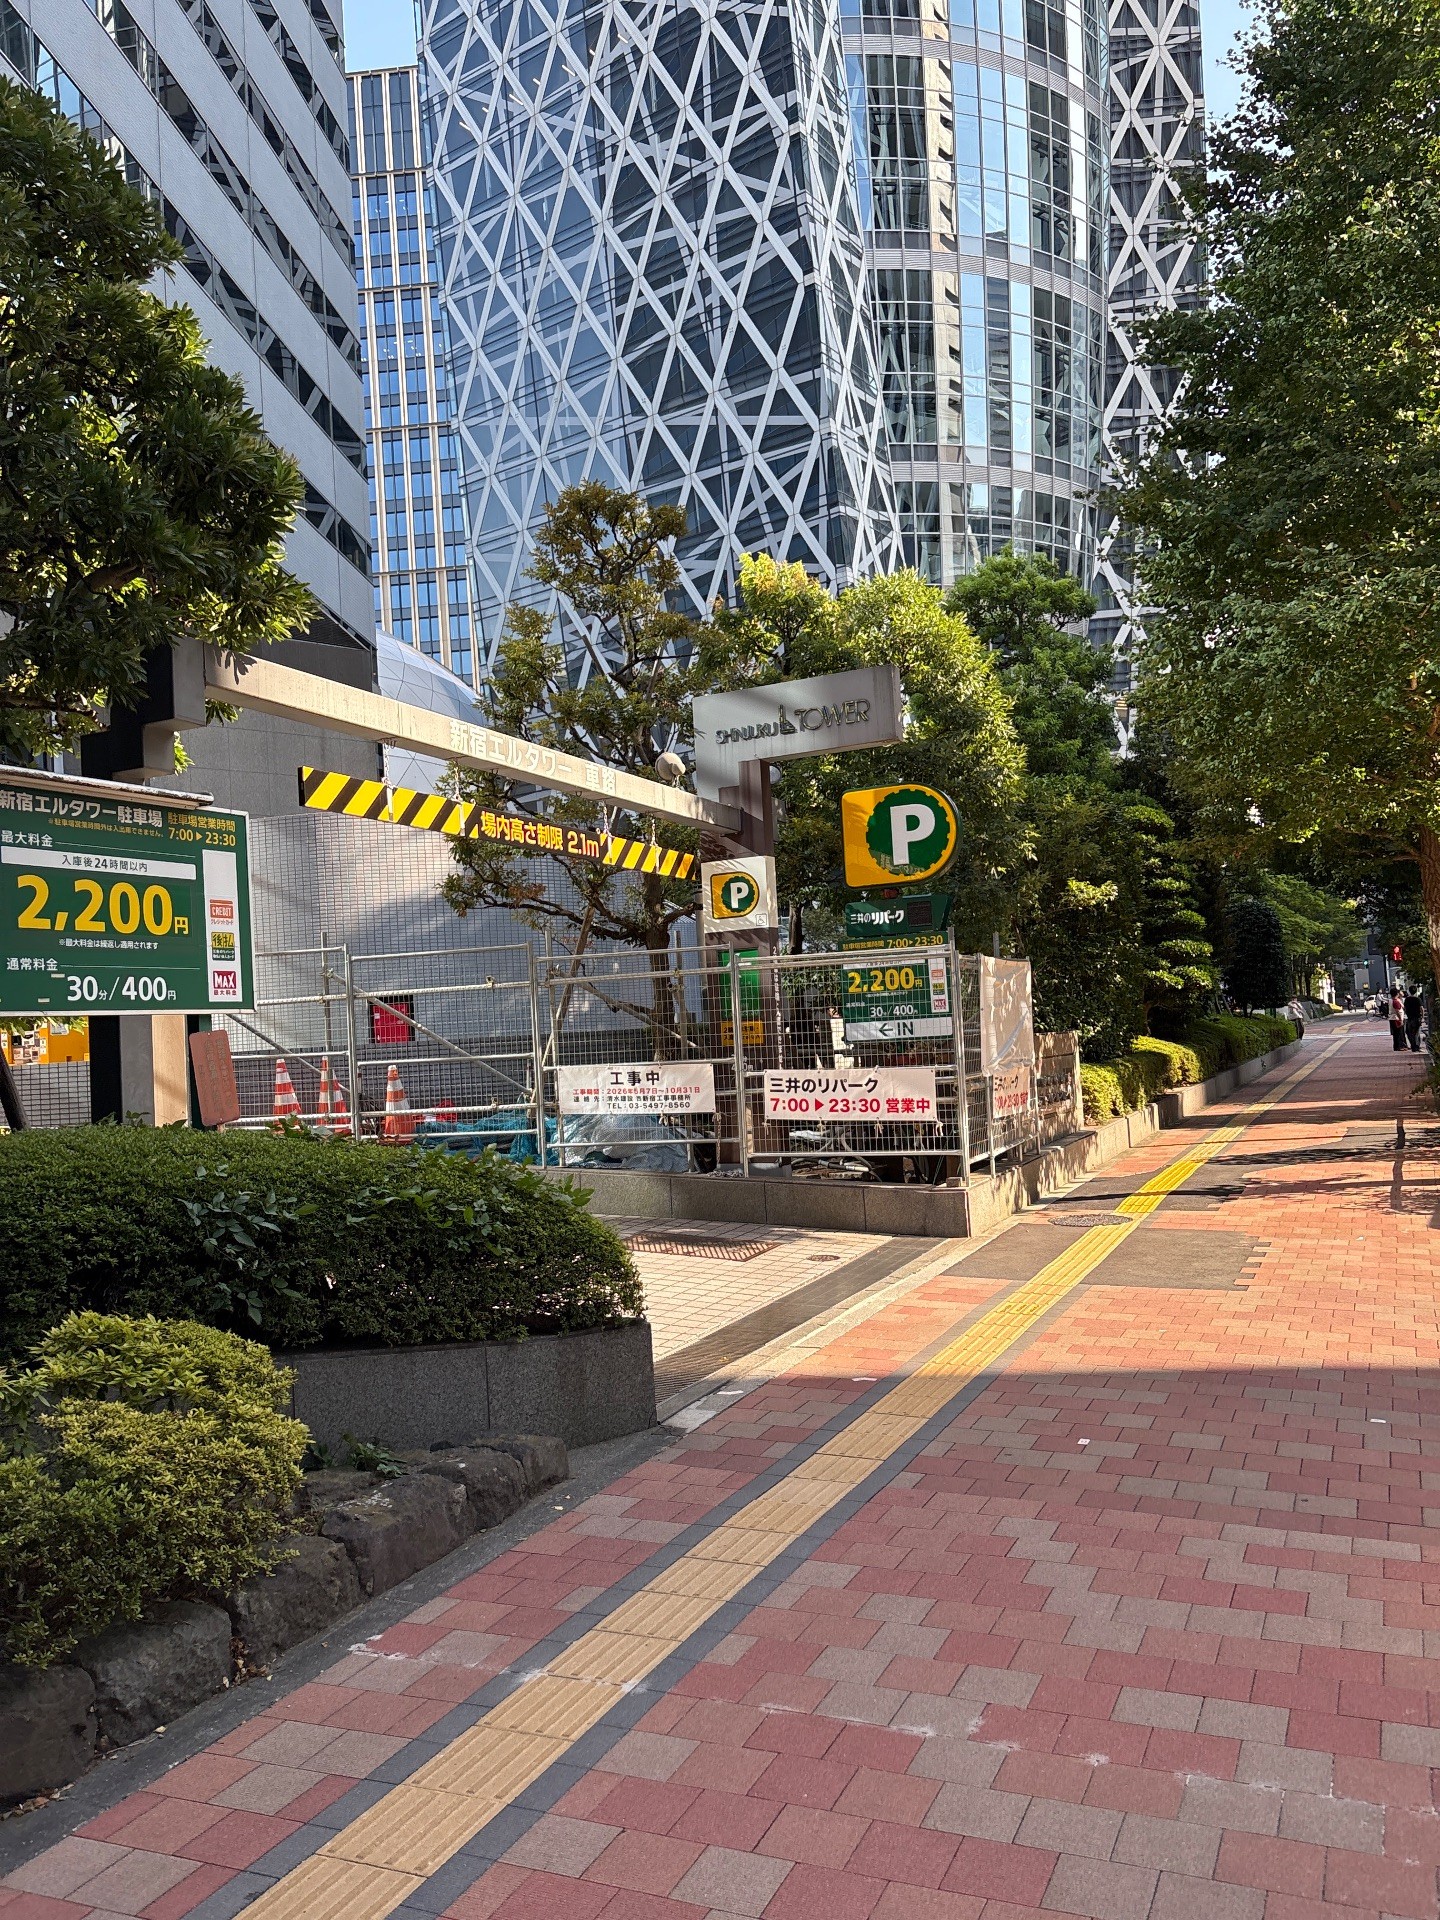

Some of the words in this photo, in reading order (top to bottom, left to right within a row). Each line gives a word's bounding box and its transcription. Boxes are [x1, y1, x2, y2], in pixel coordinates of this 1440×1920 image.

[794, 699, 871, 731] TOWER
[449, 720, 572, 776] 新宿エルタワー
[0, 789, 163, 828] 新宿エルタワー駐車場
[167, 811, 236, 833] 駐車場営業時間
[1, 830, 53, 848] 最大料金
[168, 827, 194, 842] 7:00
[205, 831, 236, 847] 23:30
[480, 810, 564, 851] 場内高さ制限
[567, 830, 600, 858] 2.1m
[890, 803, 935, 865] P
[61, 854, 148, 873] 入庫後24時間以内
[730, 881, 749, 909] P
[17, 874, 189, 936] 2,200円
[850, 909, 905, 925] 三井のリパーク
[212, 932, 234, 948] 後払
[886, 938, 909, 949] 7:00
[914, 934, 944, 947] 23:30
[6, 957, 58, 971] 通常料金
[67, 975, 176, 1001] 30分/400円
[213, 971, 235, 988] MAX
[847, 967, 923, 993] 2,200円
[897, 1021, 914, 1036] IN
[610, 1070, 660, 1086] 工事中
[769, 1077, 879, 1094] 三井のリパーク
[769, 1098, 810, 1112] 7:00
[829, 1097, 881, 1113] 23:30
[885, 1097, 931, 1114] 営業中
